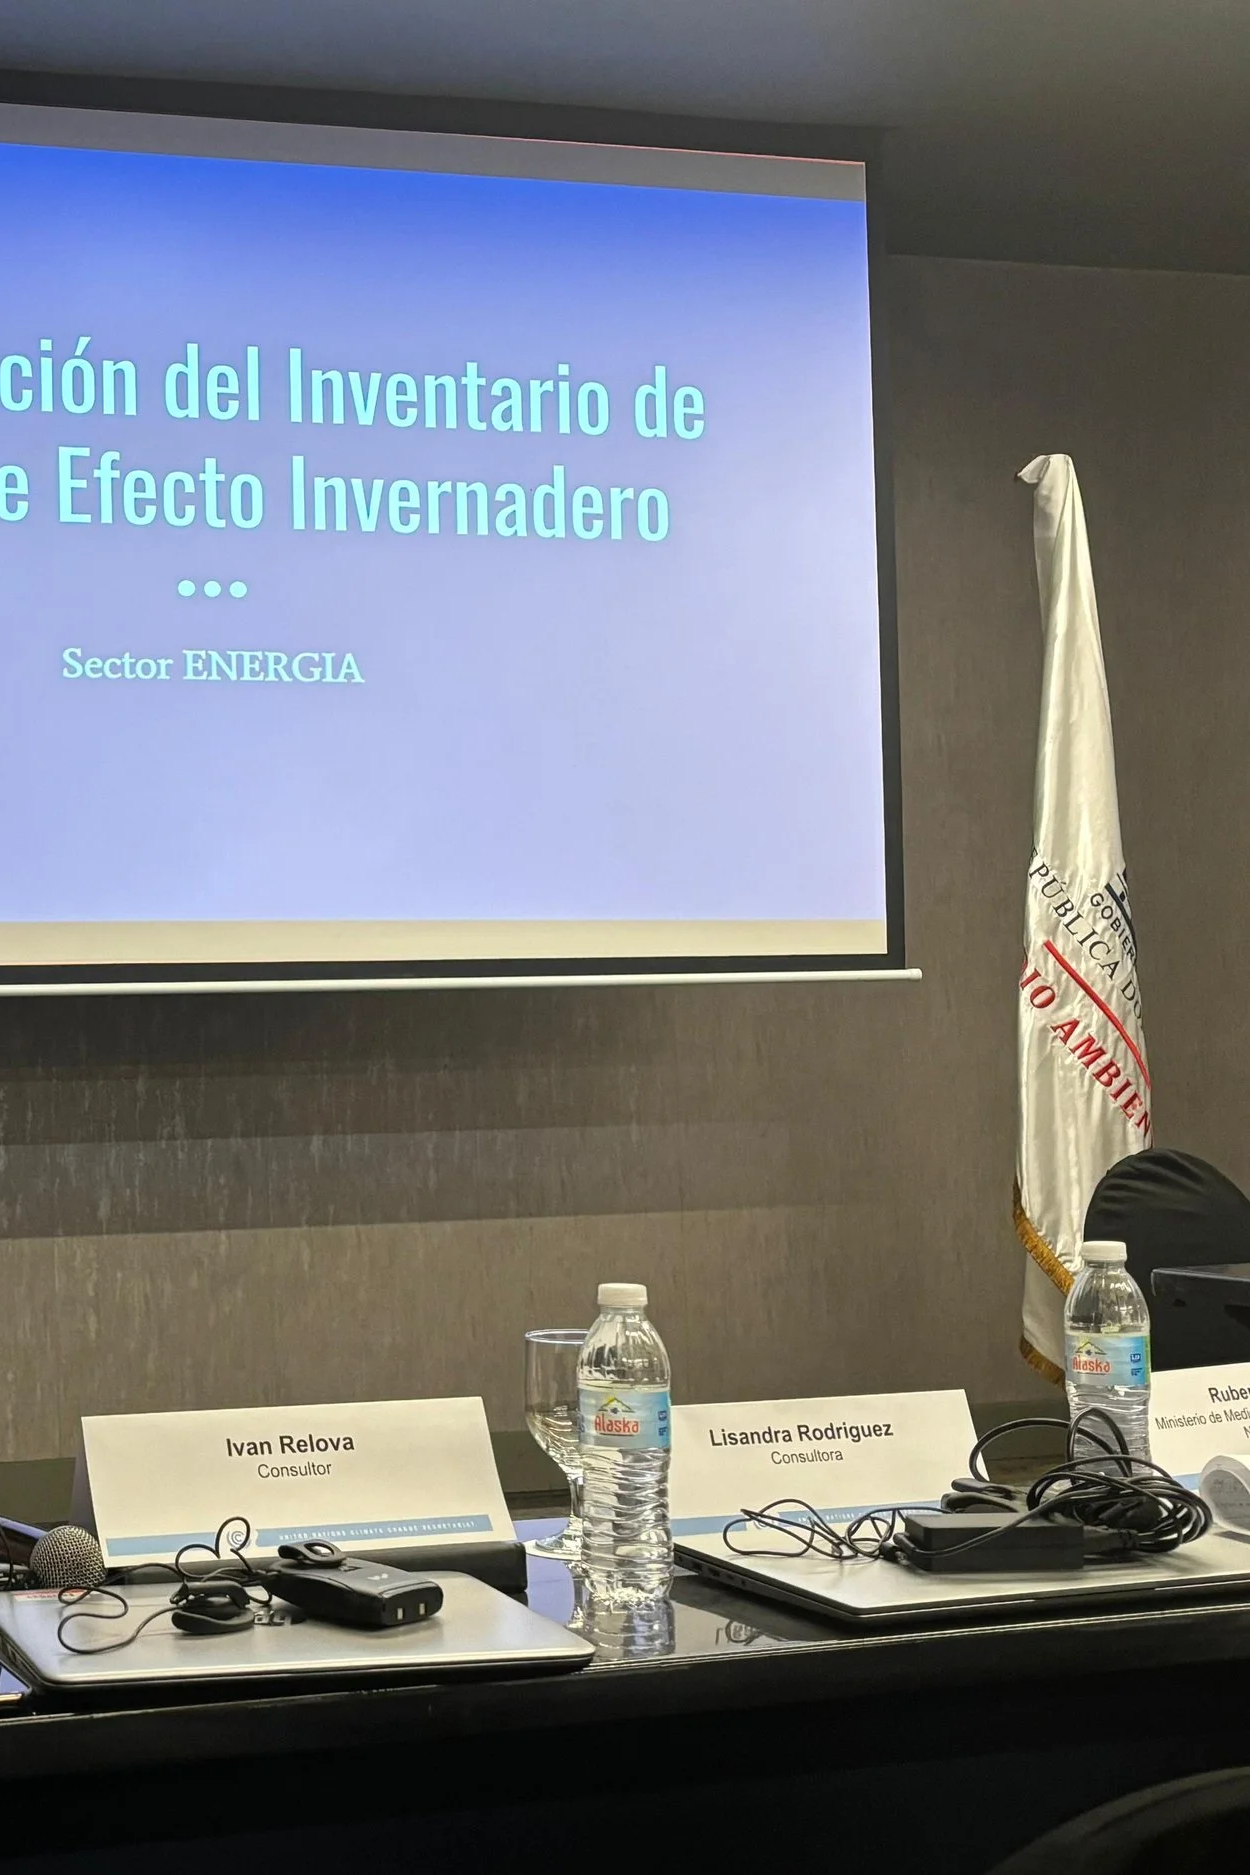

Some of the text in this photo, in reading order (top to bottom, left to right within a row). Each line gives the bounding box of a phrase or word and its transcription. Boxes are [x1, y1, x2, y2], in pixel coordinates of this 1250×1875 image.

[164, 342, 260, 421] del
[289, 347, 610, 436] Inventario
[634, 365, 706, 441] de
[58, 446, 264, 529] Efecto
[291, 456, 670, 542] Invernadero
[61, 646, 366, 684] Sector ENERGIA
[1020, 962, 1057, 1010] IO
[1073, 1356, 1111, 1373] Alaska
[594, 1412, 640, 1434] Alaska
[1154, 1412, 1207, 1431] Ministerio
[1208, 1410, 1223, 1424] de
[225, 1433, 355, 1457] Ivan Relova
[708, 1420, 894, 1447] Lisandra Rodriguez
[770, 1448, 844, 1466] Consultora
[257, 1460, 332, 1479] Consultor
[311, 1530, 346, 1539] NATIONS
